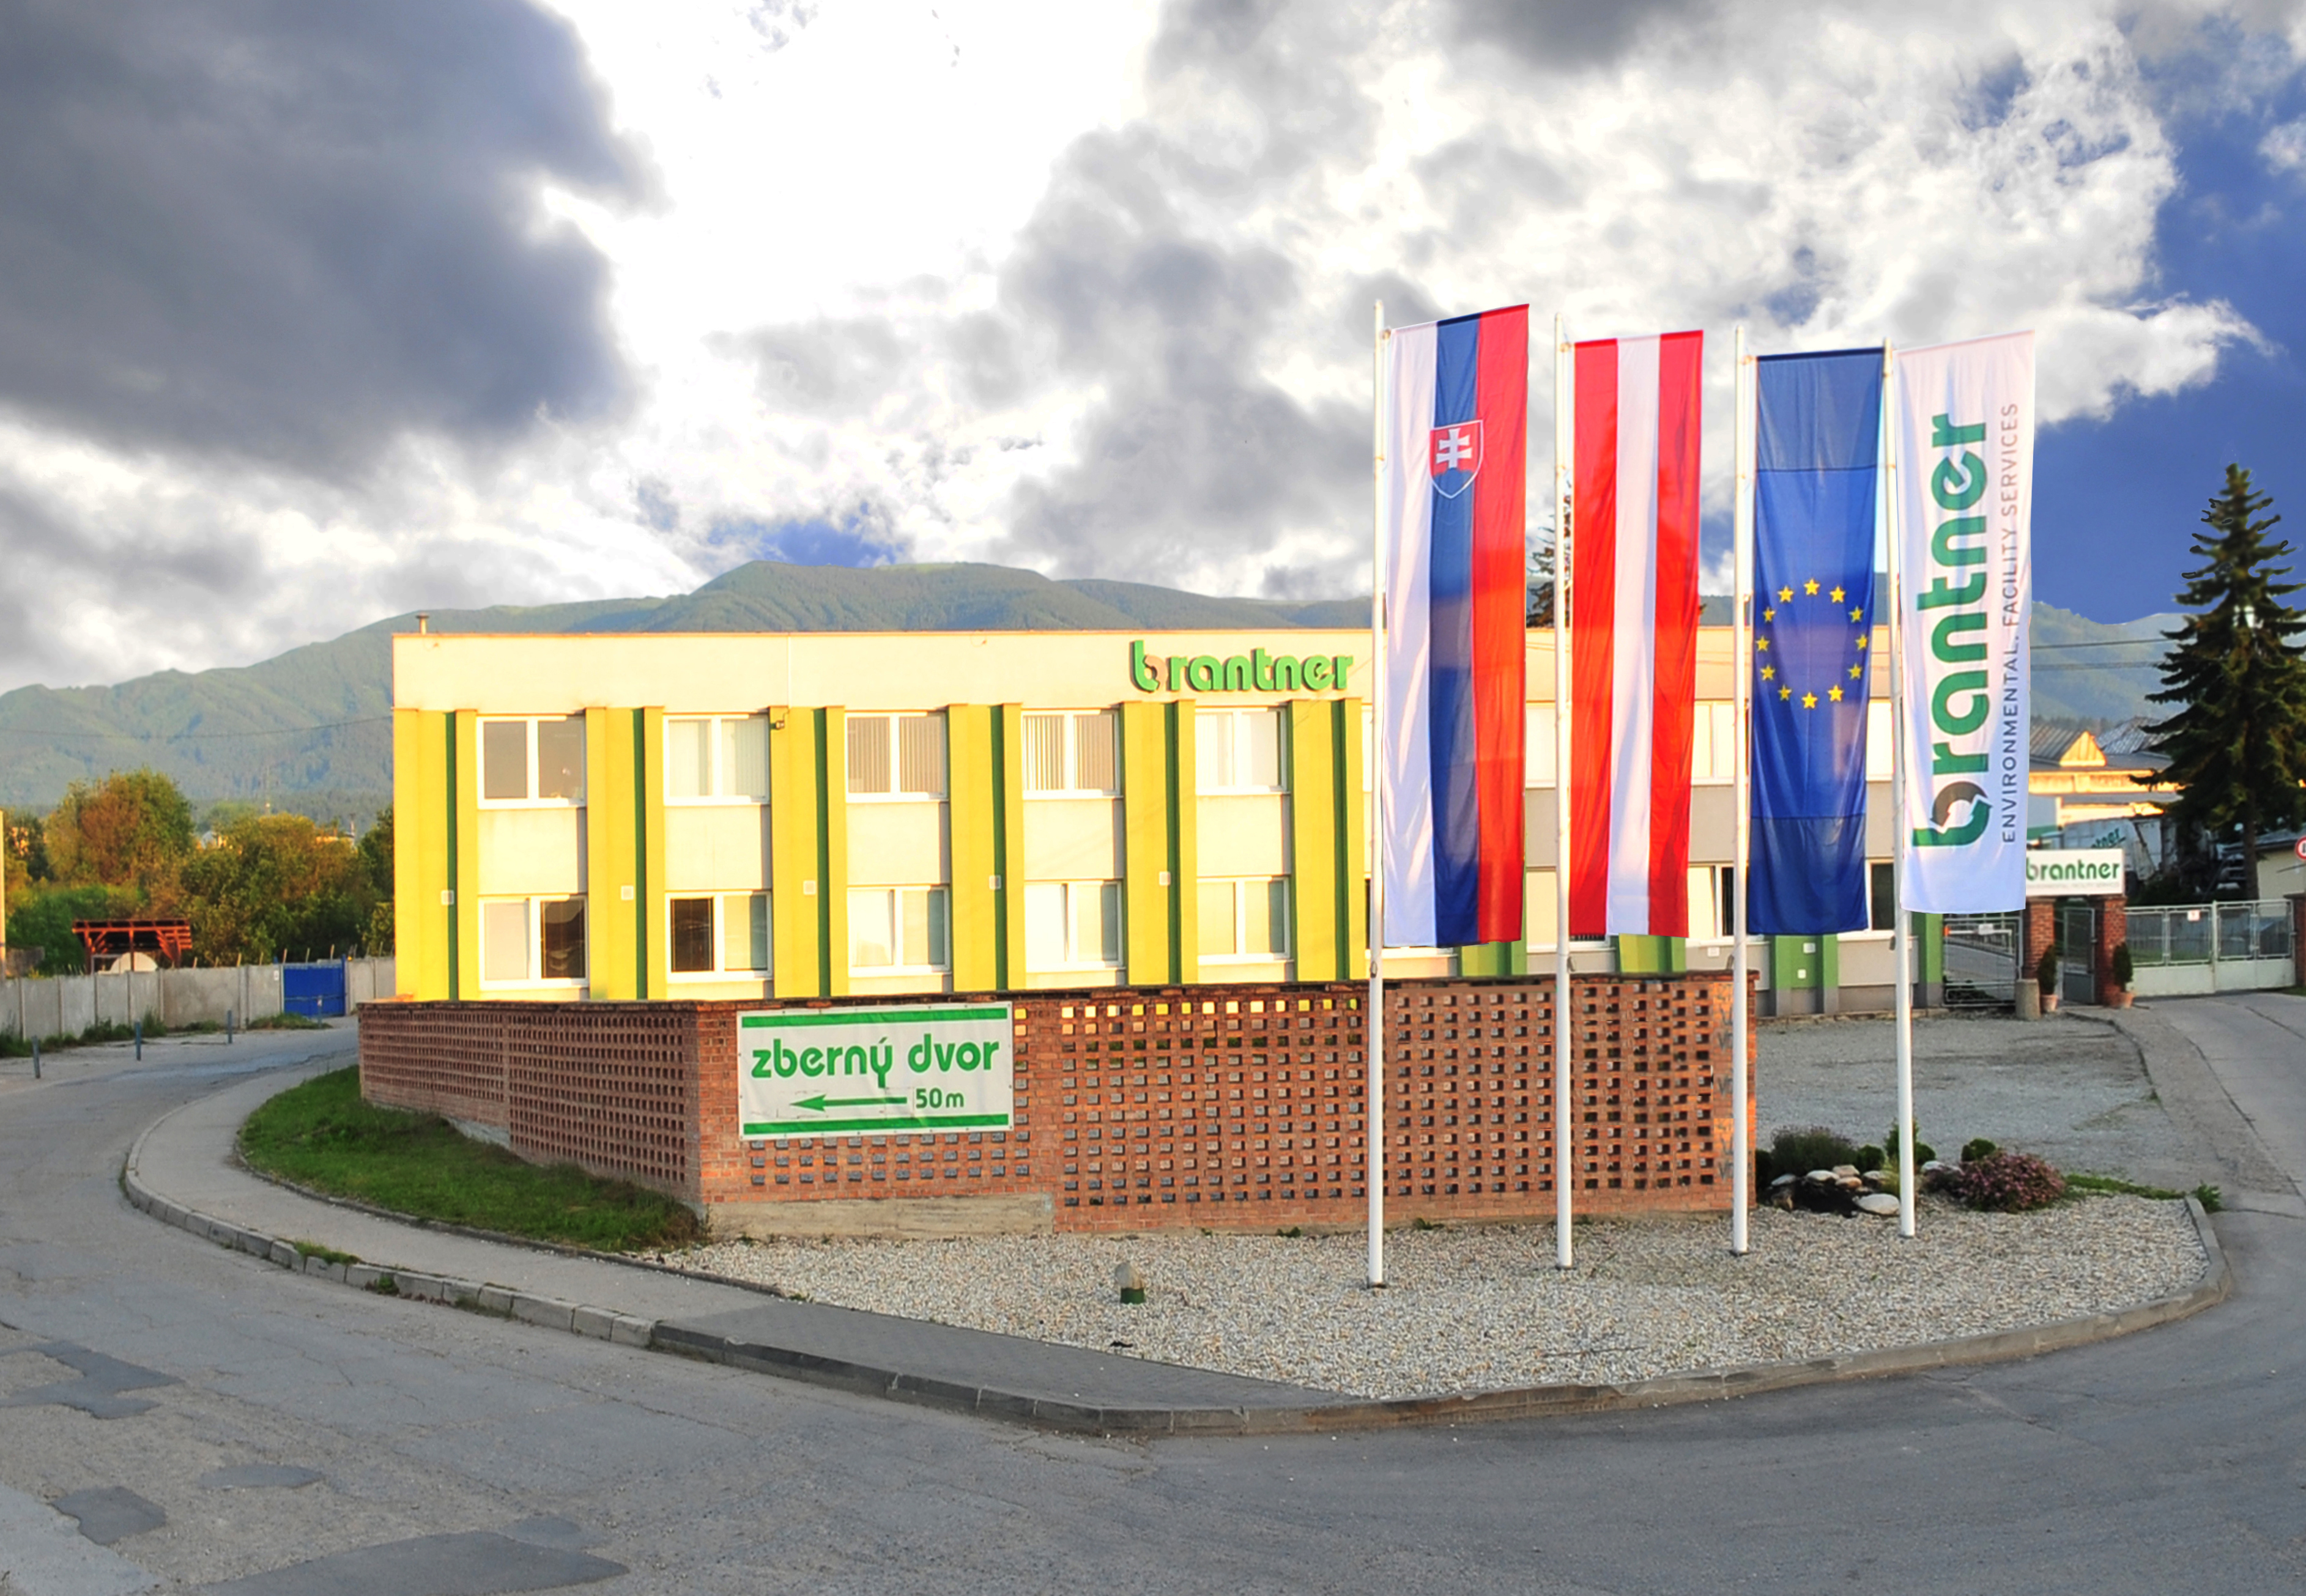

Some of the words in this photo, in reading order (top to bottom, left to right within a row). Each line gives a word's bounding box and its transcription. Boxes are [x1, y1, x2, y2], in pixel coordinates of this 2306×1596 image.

[2001, 404, 2018, 517] SERVICES
[2001, 528, 2019, 627] FACILITY
[1129, 640, 1354, 692] brantner
[1912, 413, 1993, 847] brantner
[2026, 857, 2120, 881] brantner
[751, 1036, 893, 1088] zberný
[908, 1033, 999, 1073] dvor
